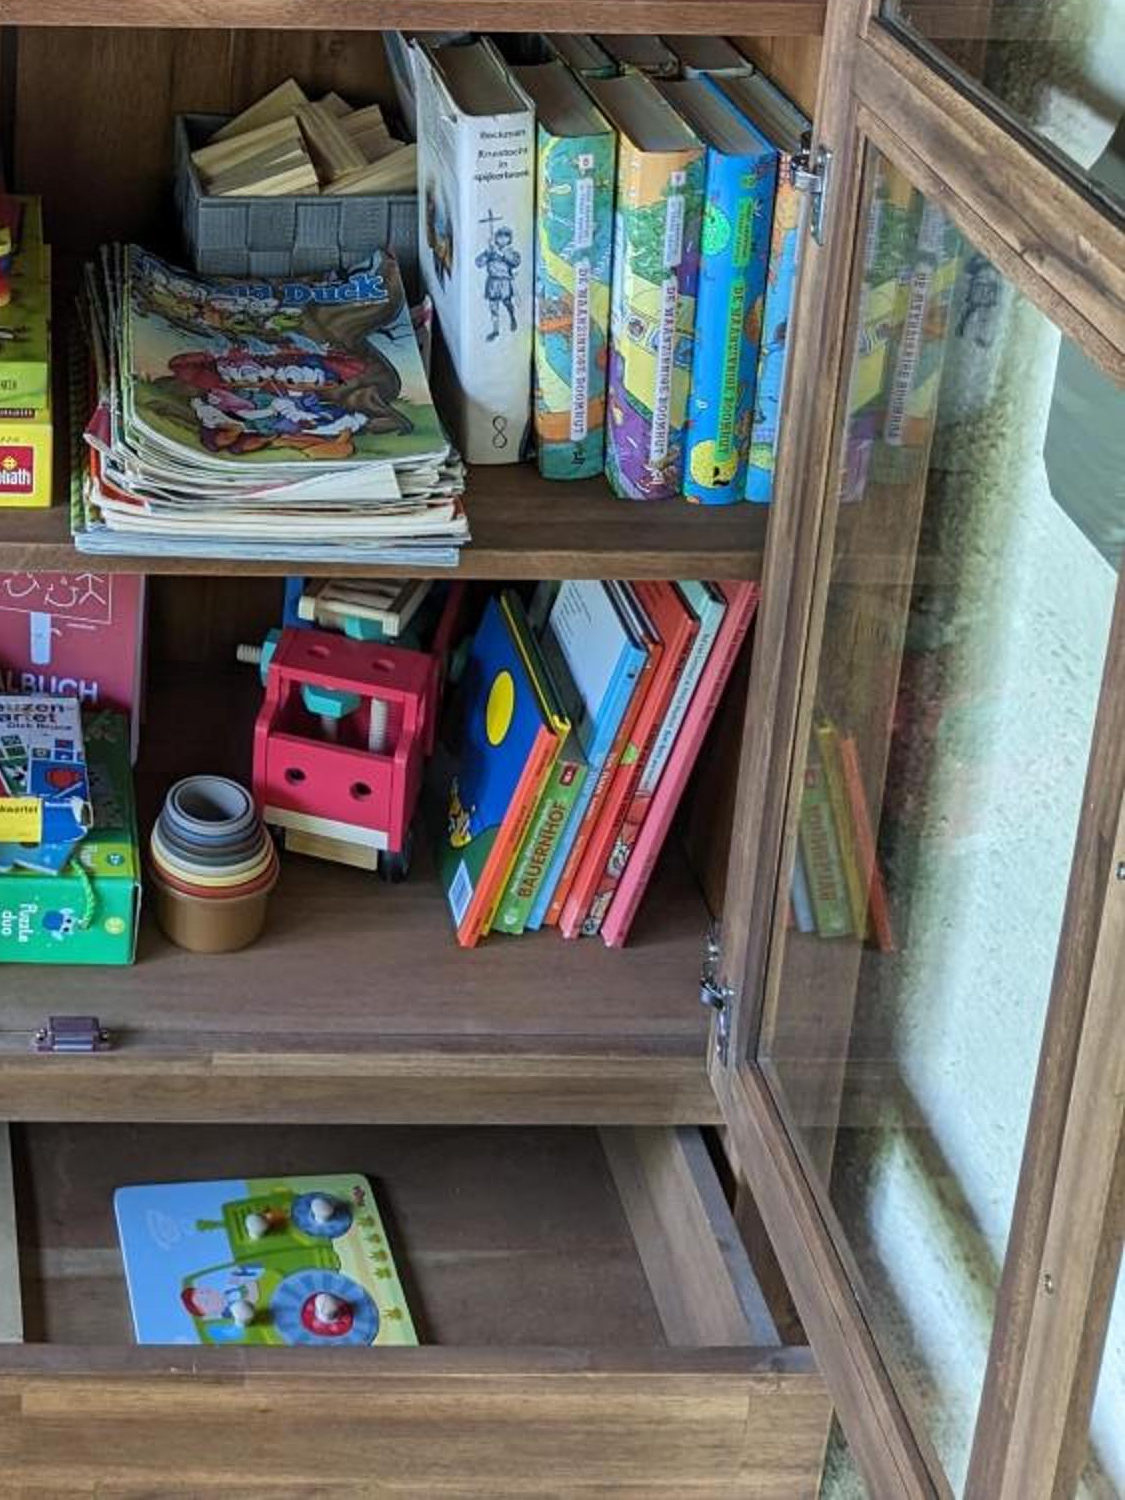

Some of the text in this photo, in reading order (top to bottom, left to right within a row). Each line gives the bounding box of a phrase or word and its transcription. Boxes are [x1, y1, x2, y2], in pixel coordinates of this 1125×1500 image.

[279, 274, 389, 304] Duck
[572, 265, 589, 434] DE WAANZINNIGE BOOMHUT
[655, 285, 677, 455] DE WAANZINNIGE BOOMHUT
[719, 284, 745, 454] DE WAANZINNIGE BOOMHUT
[518, 802, 567, 901] BAUERNHOF
[0, 909, 16, 938] duo
[17, 902, 39, 945] Puzzle
